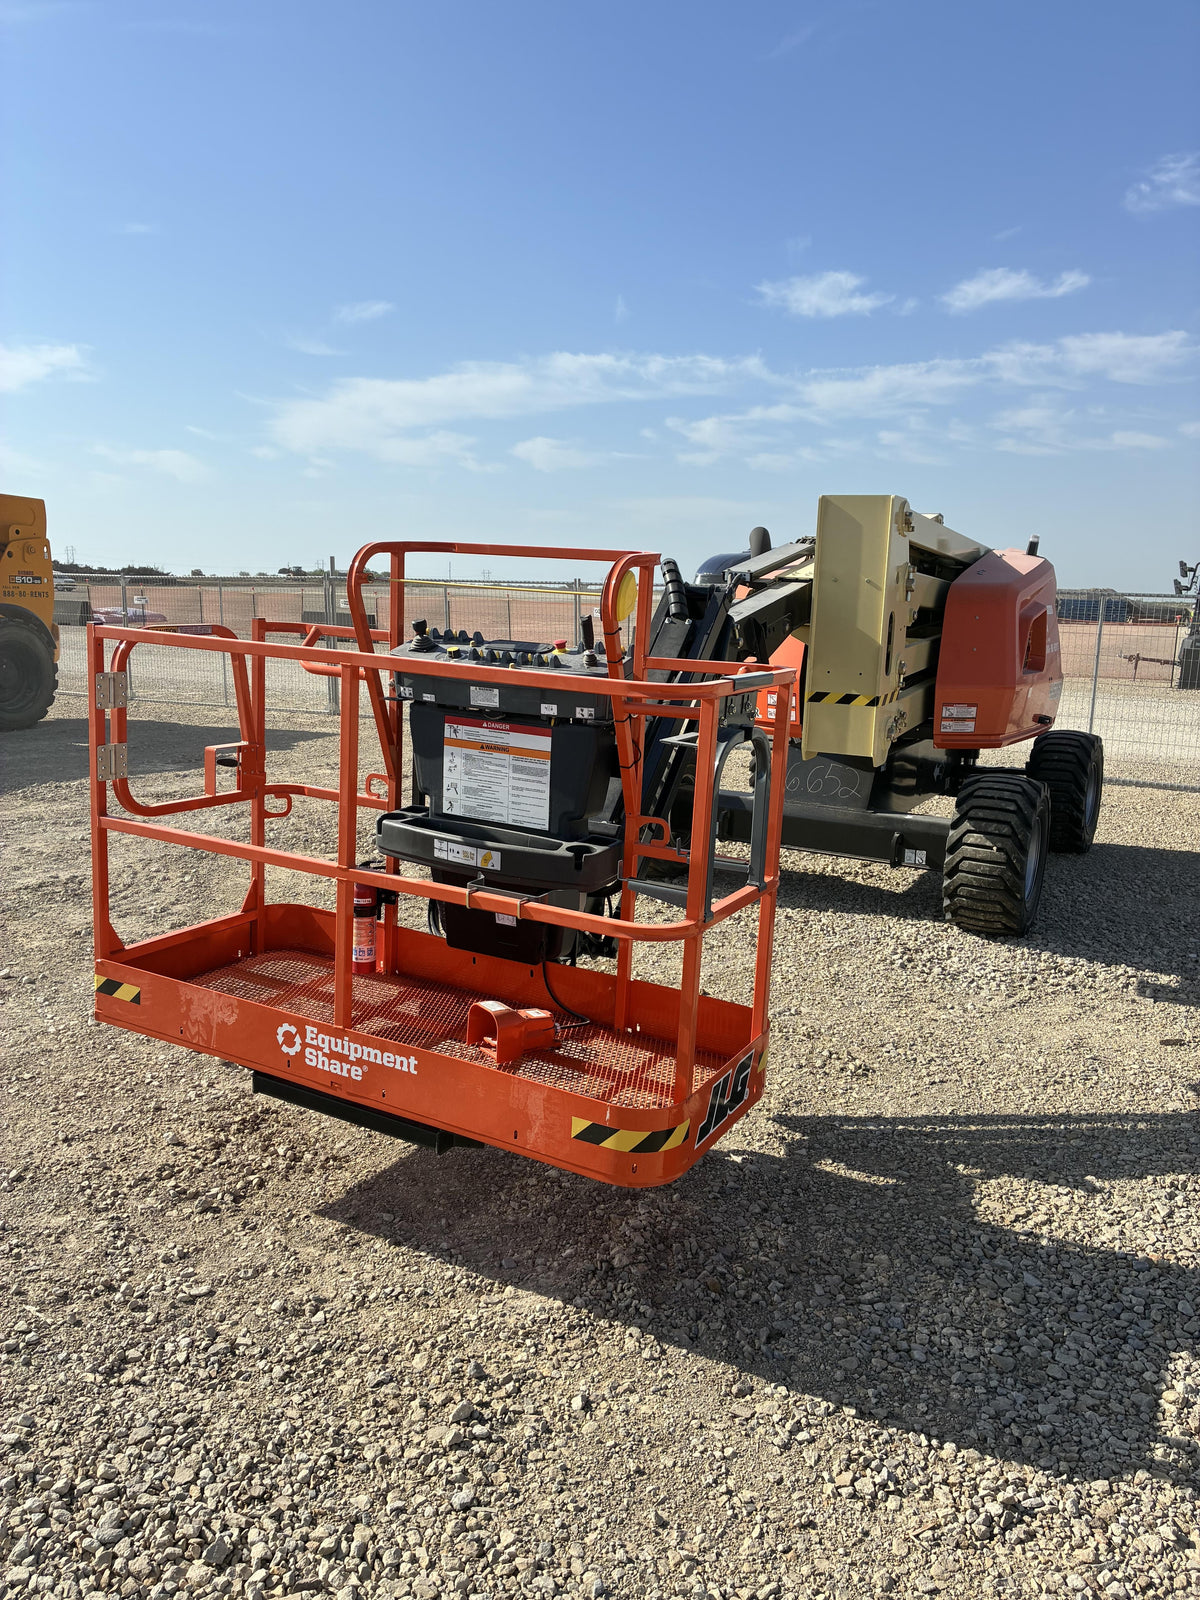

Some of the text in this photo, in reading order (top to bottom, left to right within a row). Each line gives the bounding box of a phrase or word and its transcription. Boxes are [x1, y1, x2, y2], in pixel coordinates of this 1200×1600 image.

[487, 721, 510, 731] DANGER
[485, 744, 510, 753] WARNING
[304, 1025, 419, 1075] Equipment
[694, 1047, 756, 1150] JLG
